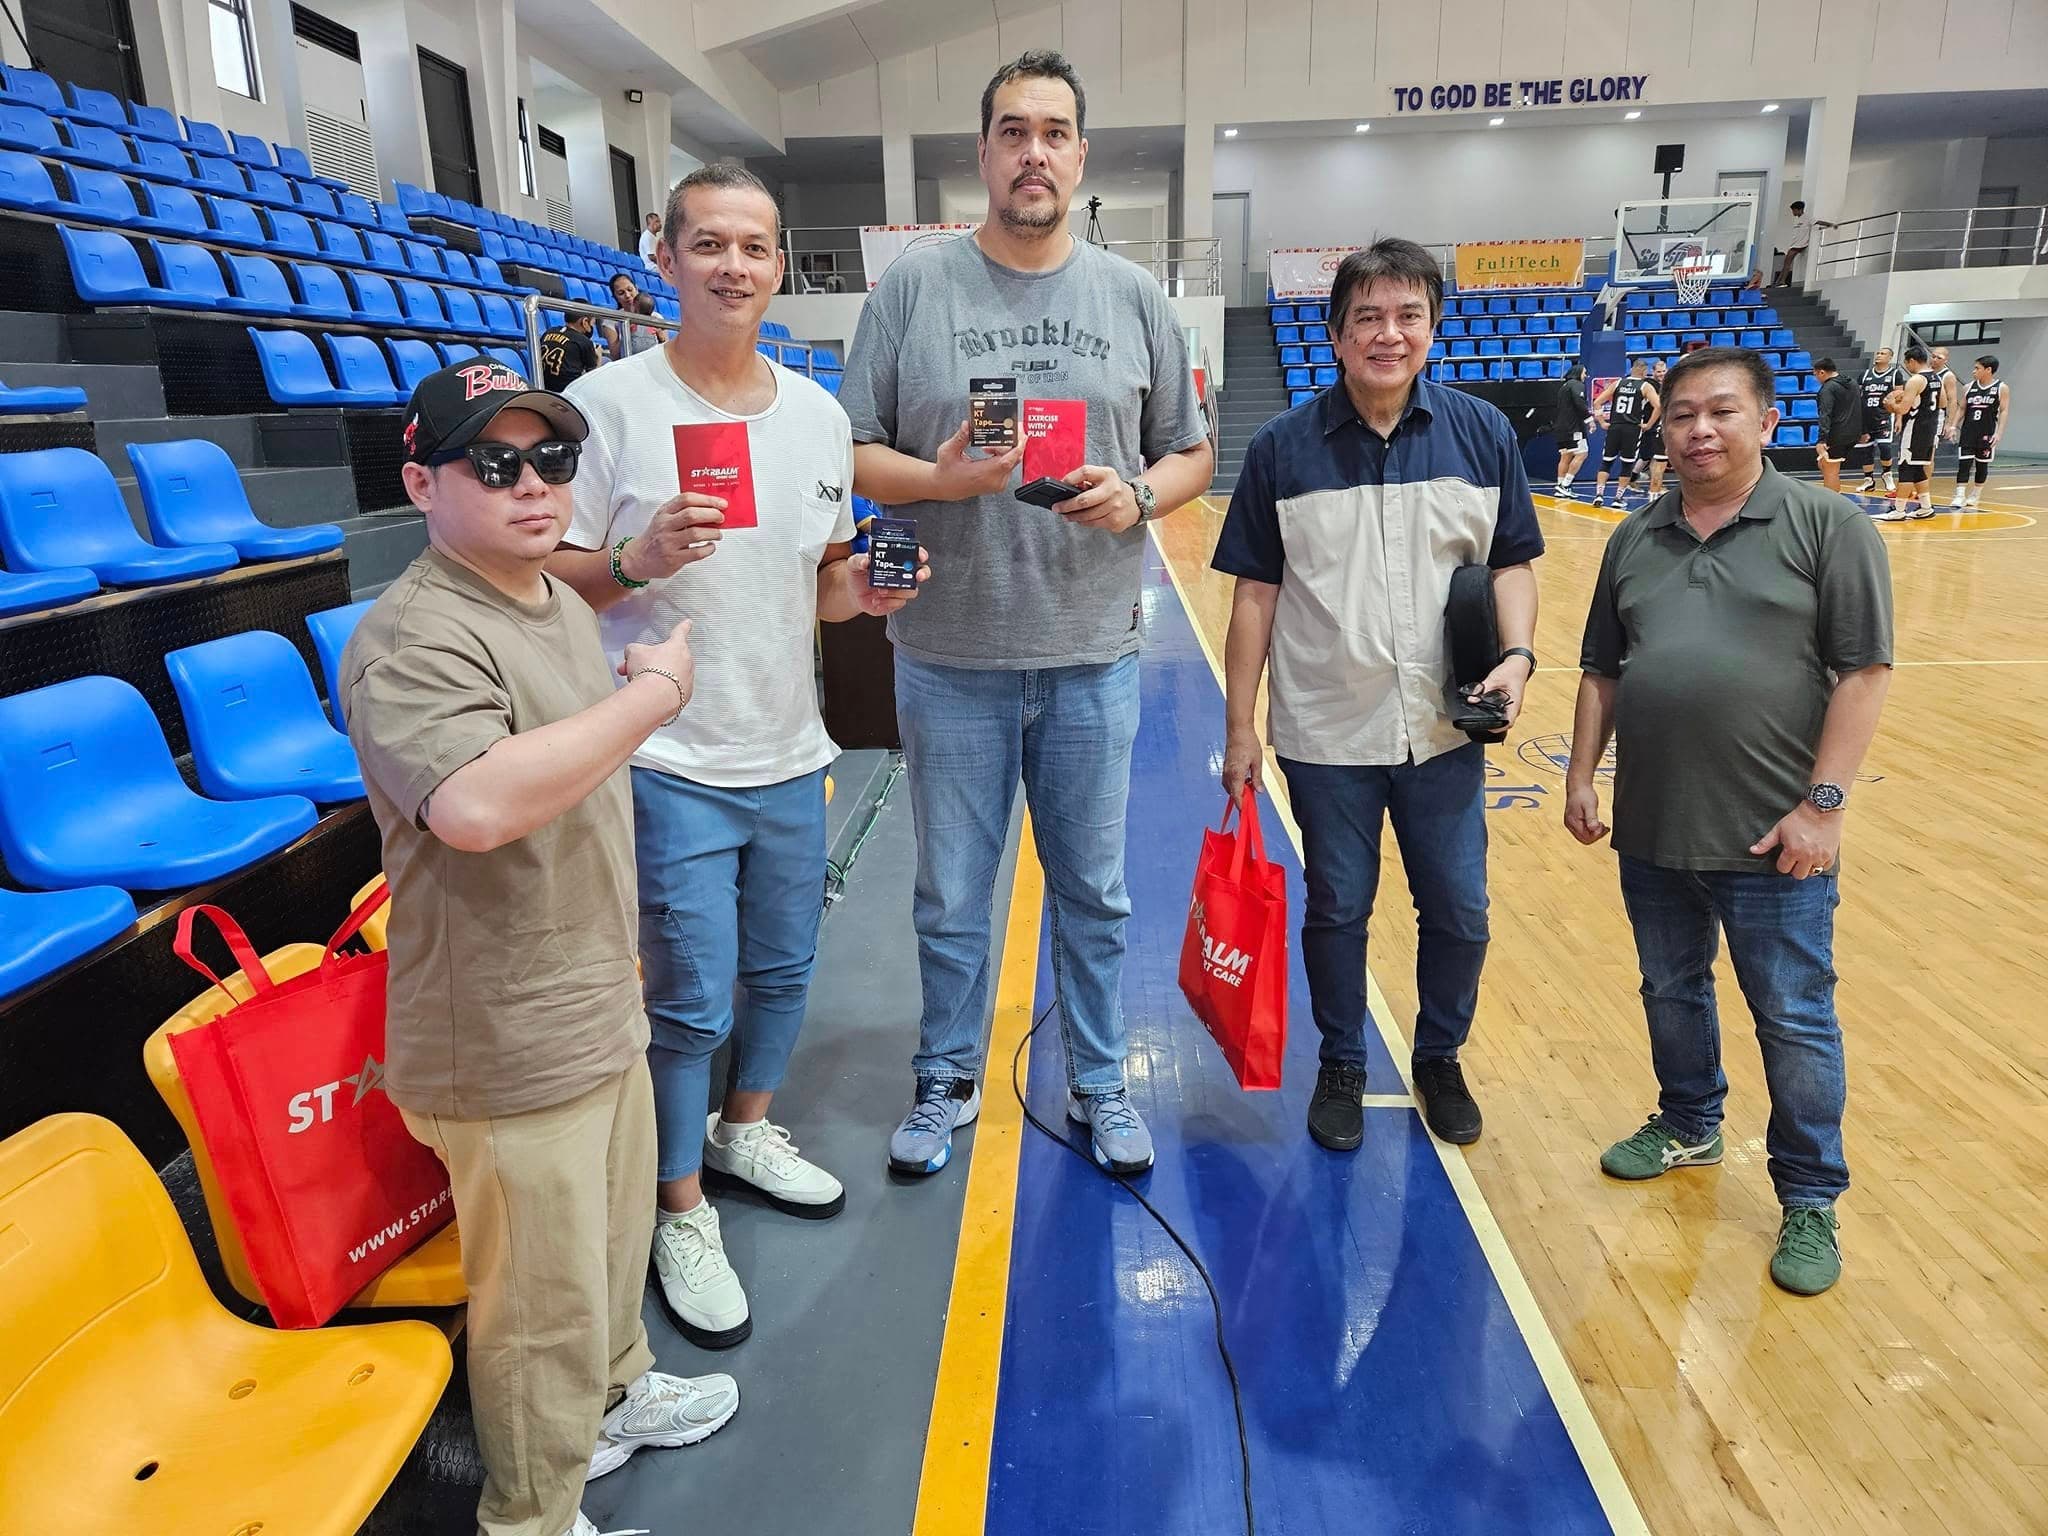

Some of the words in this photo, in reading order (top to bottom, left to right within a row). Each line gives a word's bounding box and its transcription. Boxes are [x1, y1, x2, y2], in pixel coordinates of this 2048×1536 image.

[1394, 87, 1423, 111] TO
[1430, 84, 1476, 110] GOD
[1484, 82, 1512, 108] BE
[1519, 80, 1563, 105] THE
[1569, 76, 1648, 103] GLORY
[1477, 255, 1560, 270] FuliTech
[953, 316, 1111, 360] Brooklyn
[1011, 359, 1058, 372] FUBU
[1616, 396, 1634, 414] 61
[1867, 397, 1880, 407] 85
[1930, 390, 1938, 411] 5
[1973, 410, 1982, 420] 8
[974, 419, 993, 427] Tape
[1028, 422, 1046, 430] WITH
[875, 551, 886, 559] KT
[875, 560, 894, 569] Tape
[1212, 967, 1243, 988] CARE
